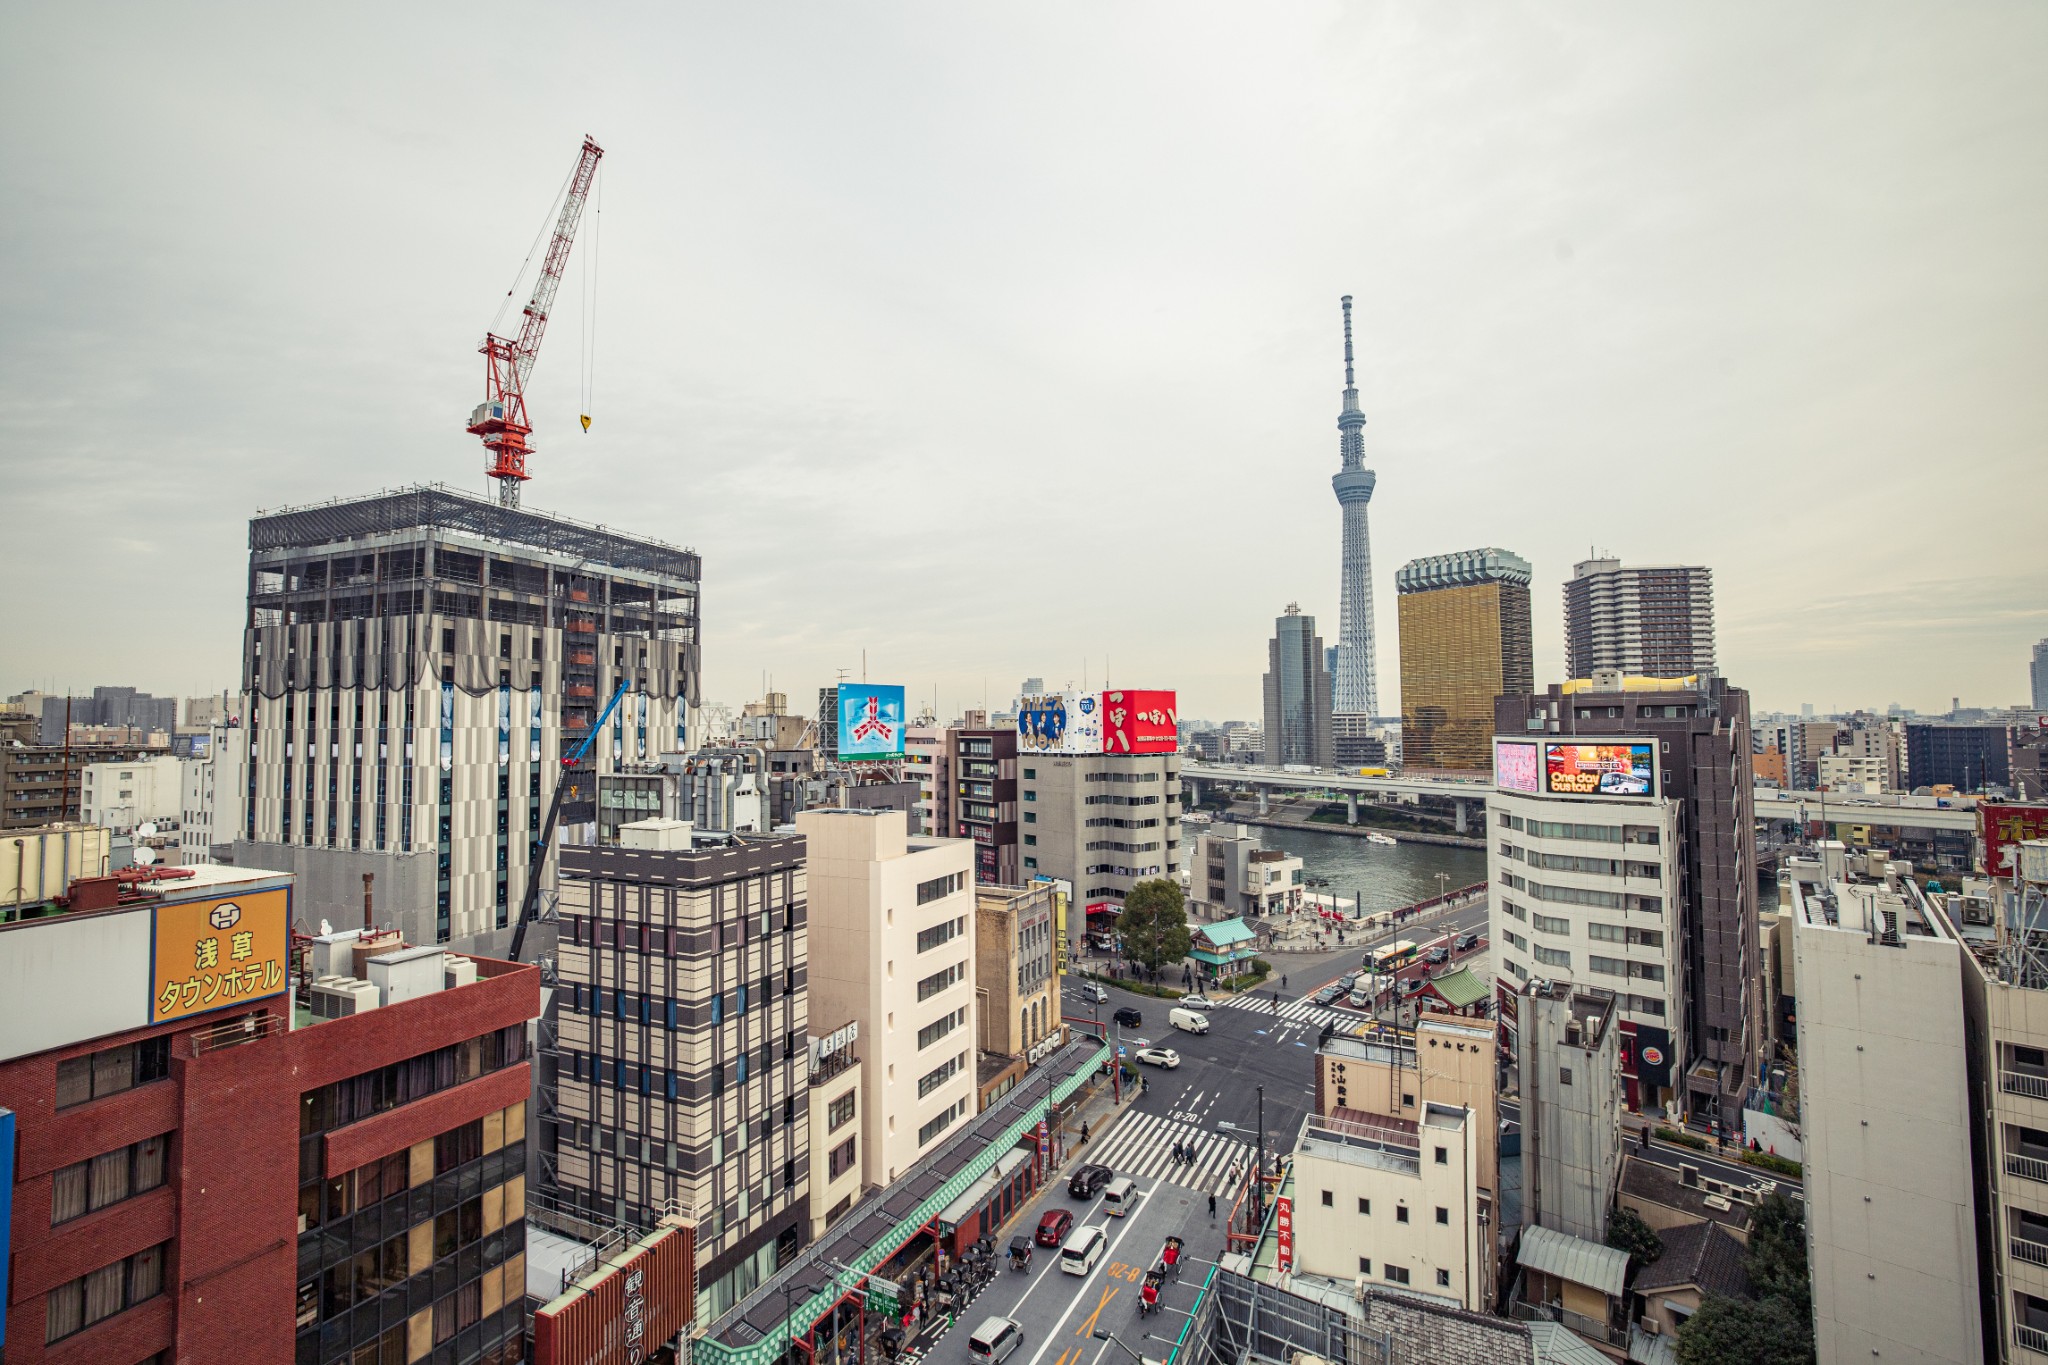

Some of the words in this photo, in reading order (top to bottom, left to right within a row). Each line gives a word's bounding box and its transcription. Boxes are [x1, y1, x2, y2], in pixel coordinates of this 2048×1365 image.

[1021, 696, 1063, 711] カルピス
[1551, 772, 1576, 784] One
[1576, 773, 1600, 786] day
[1551, 781, 1572, 792] bus
[1571, 782, 1596, 793] tour
[1997, 815, 2048, 841] ホ
[195, 931, 253, 970] 浅草
[159, 959, 282, 1014] タウンホテル
[1429, 1038, 1480, 1054] 中山ビル
[1173, 1111, 1198, 1122] 8-20
[1107, 1261, 1141, 1283] 8-20
